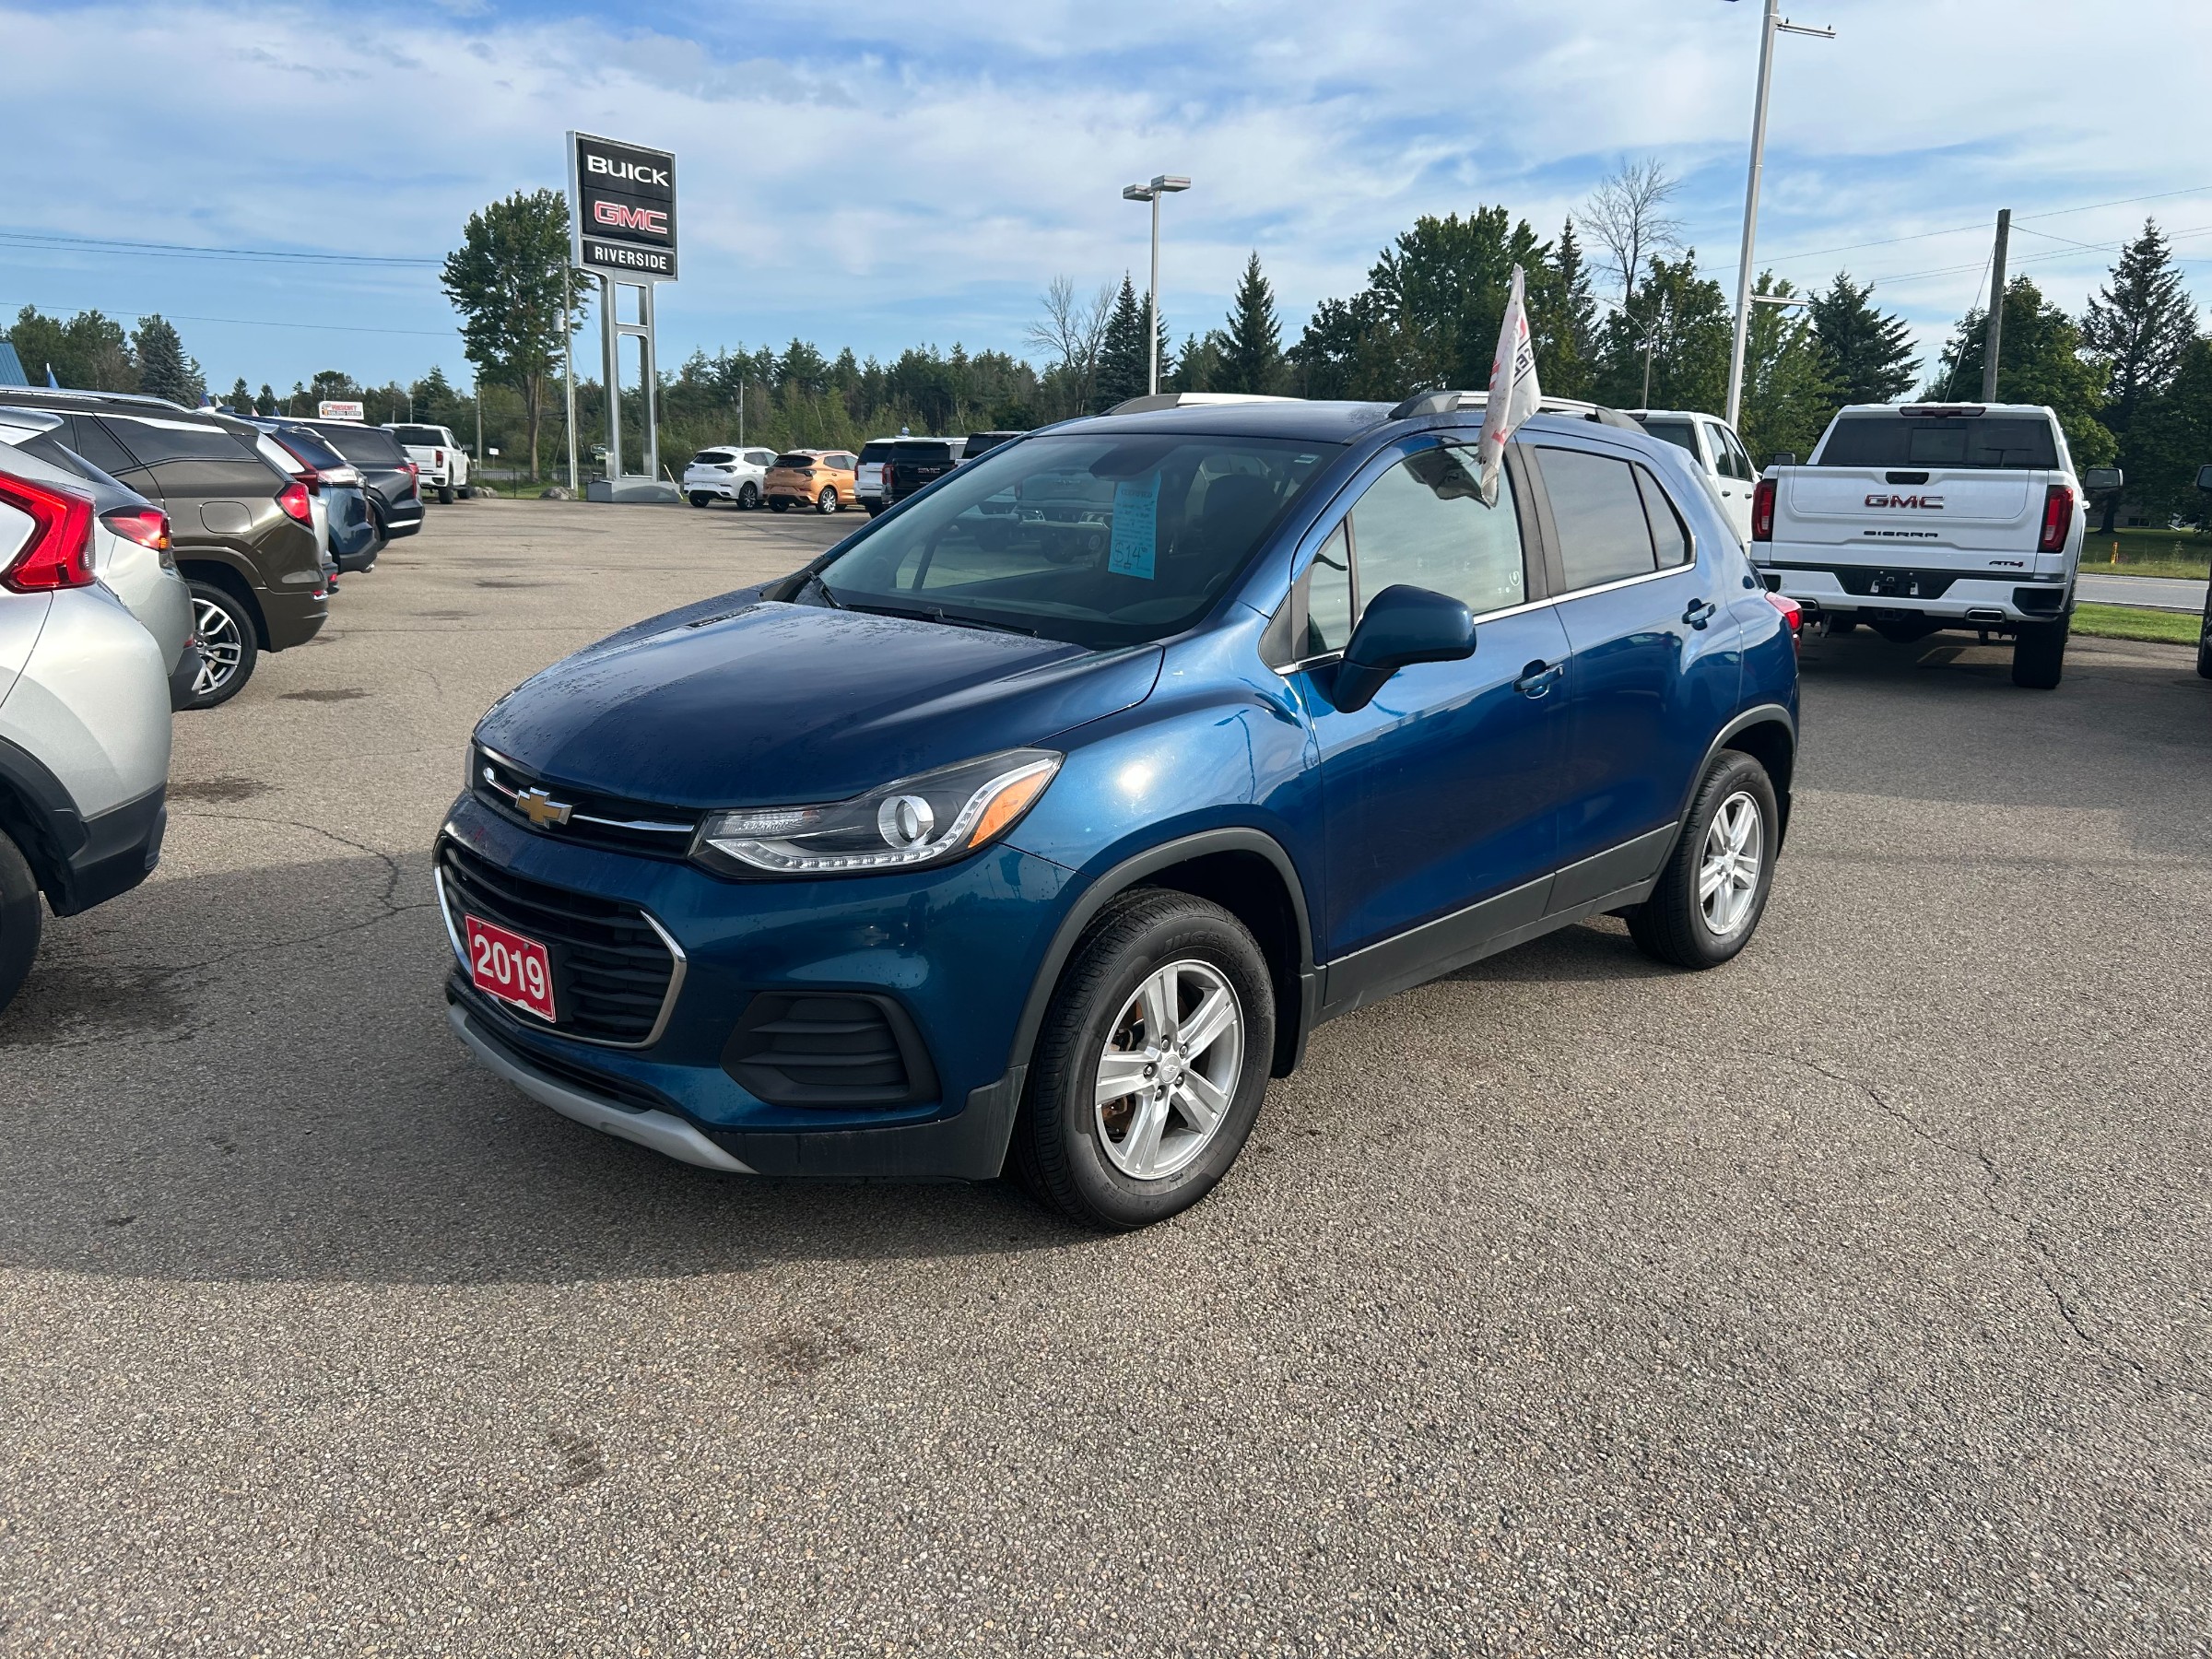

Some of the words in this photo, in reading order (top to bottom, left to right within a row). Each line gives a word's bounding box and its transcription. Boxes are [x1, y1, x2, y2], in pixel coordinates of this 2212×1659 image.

[587, 155, 670, 187] BUICK
[594, 200, 668, 234] GMC
[594, 246, 667, 269] RIVERSIDE
[1865, 494, 1945, 509] GMC
[474, 934, 546, 1000] 2019
